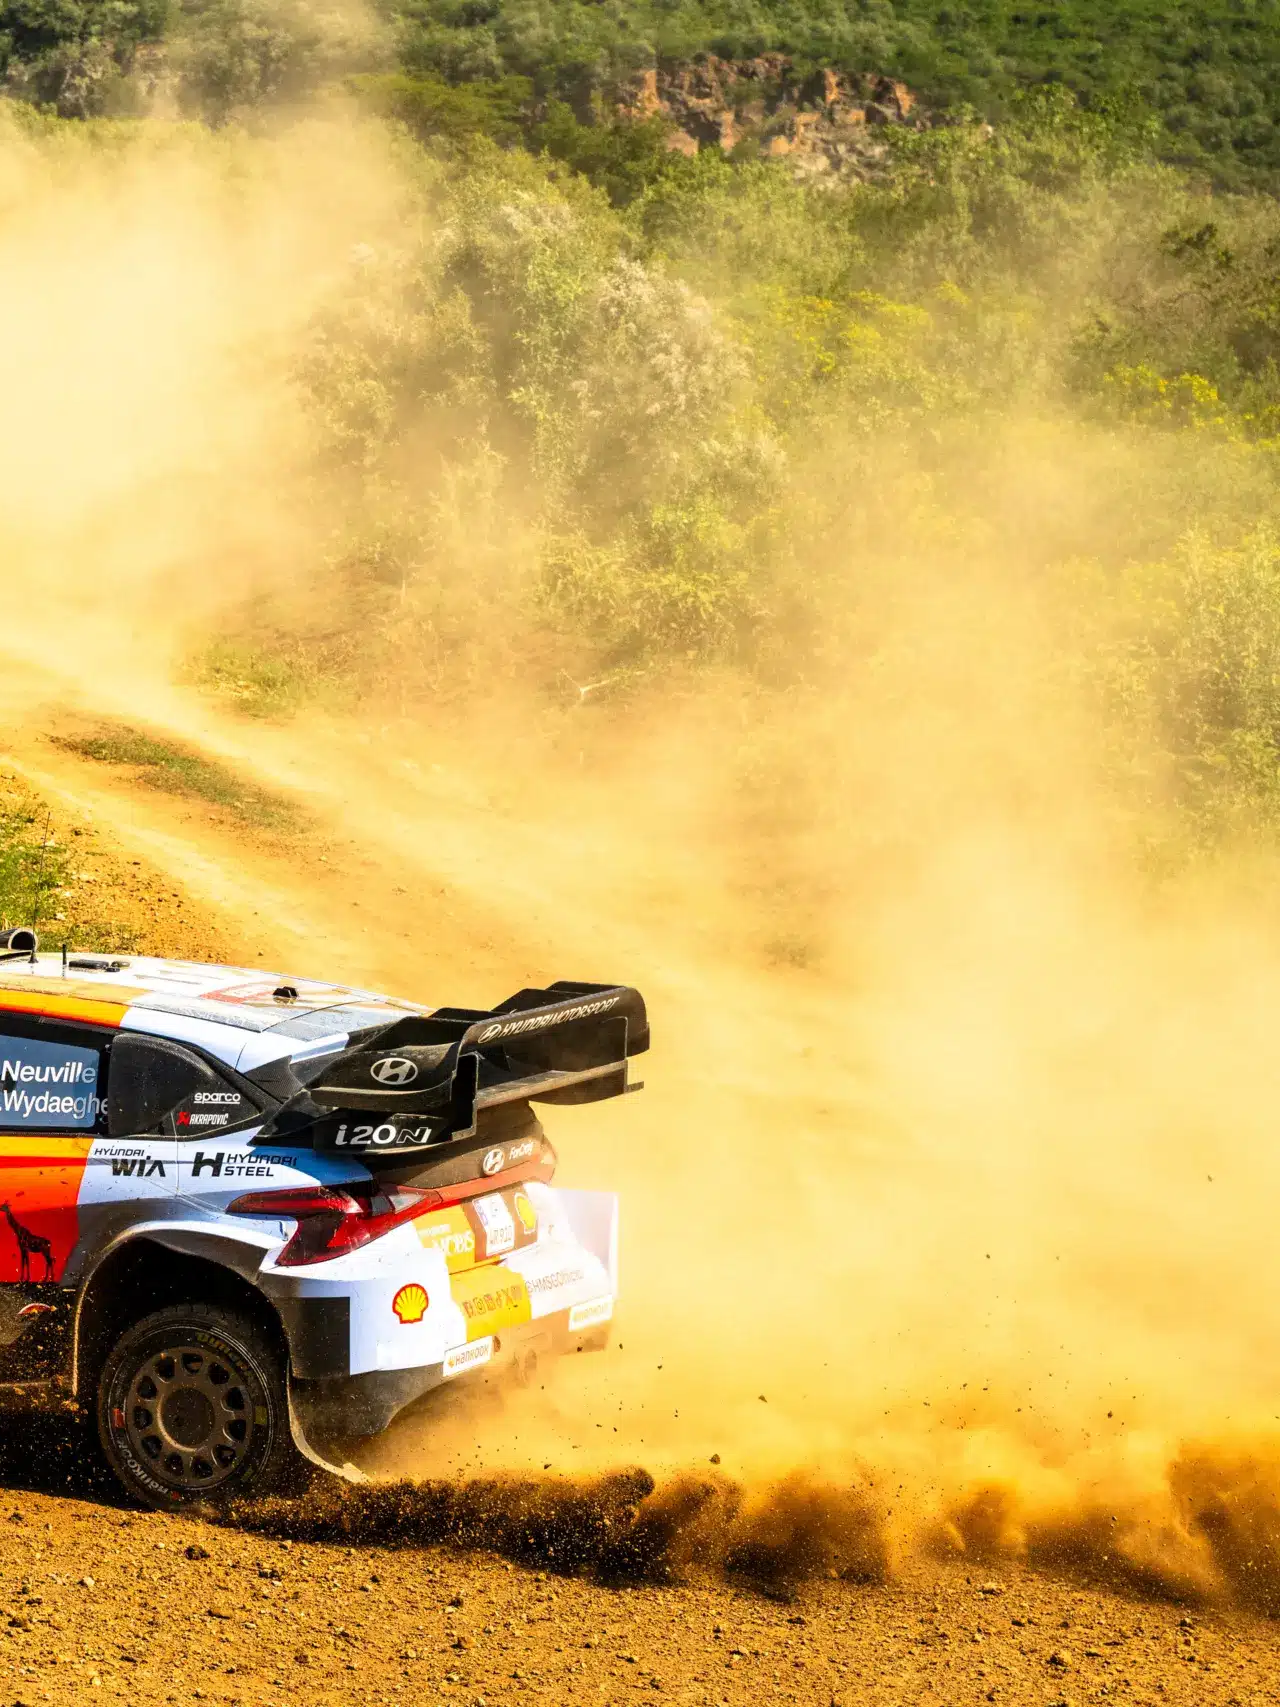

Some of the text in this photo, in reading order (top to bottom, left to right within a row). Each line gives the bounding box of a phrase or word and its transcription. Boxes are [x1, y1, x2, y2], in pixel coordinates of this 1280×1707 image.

[194, 1092, 241, 1104] sparco
[94, 1147, 146, 1157] HYUNDAI
[225, 1152, 297, 1167] HYUNDAI
[224, 1166, 274, 1177] STEEL
